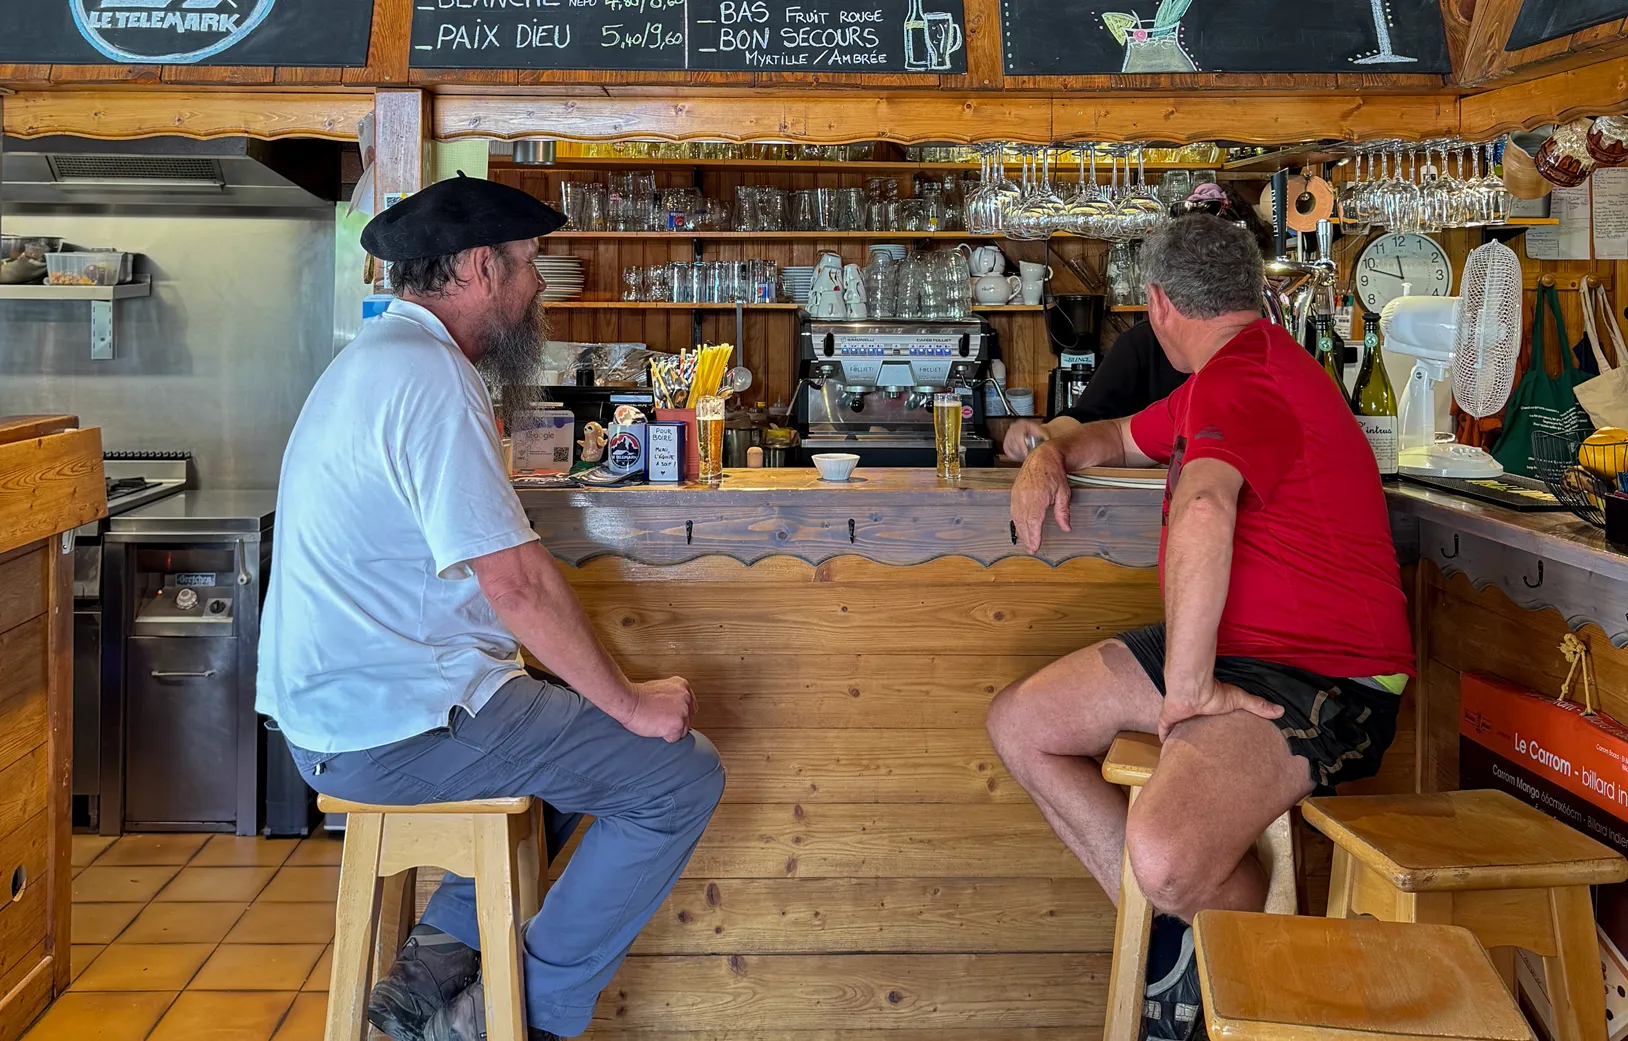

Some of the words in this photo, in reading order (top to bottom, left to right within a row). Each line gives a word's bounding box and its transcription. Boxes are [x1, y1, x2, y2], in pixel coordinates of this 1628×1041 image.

[720, 1, 769, 24] BAS
[786, 6, 829, 24] FRUIT
[840, 9, 883, 23] ROUGE
[89, 11, 112, 28] LE
[115, 11, 241, 33] TELEMARK
[437, 19, 500, 49] PAIX
[516, 19, 570, 49] DIEU
[601, 22, 683, 49] 5,40/9,60
[720, 27, 769, 51] BON
[780, 26, 879, 47] SECOURS
[745, 50, 808, 67] MYRTILLE
[1392, 235, 1405, 247] 12
[1417, 240, 1422, 250] 1
[1374, 243, 1384, 254] 11
[1363, 258, 1375, 269] 10
[1431, 252, 1439, 263] 2
[1361, 275, 1368, 286] 9
[1436, 269, 1444, 280] 3
[1368, 294, 1376, 304] 8
[1514, 732, 1526, 754] Le
[1529, 740, 1571, 777] Carrom
[1582, 766, 1615, 800] billard
[1492, 764, 1515, 786] Carrom
[1516, 776, 1540, 799] Mango
[1541, 791, 1582, 821] 66cmx66cm
[1587, 816, 1608, 837] Billard
